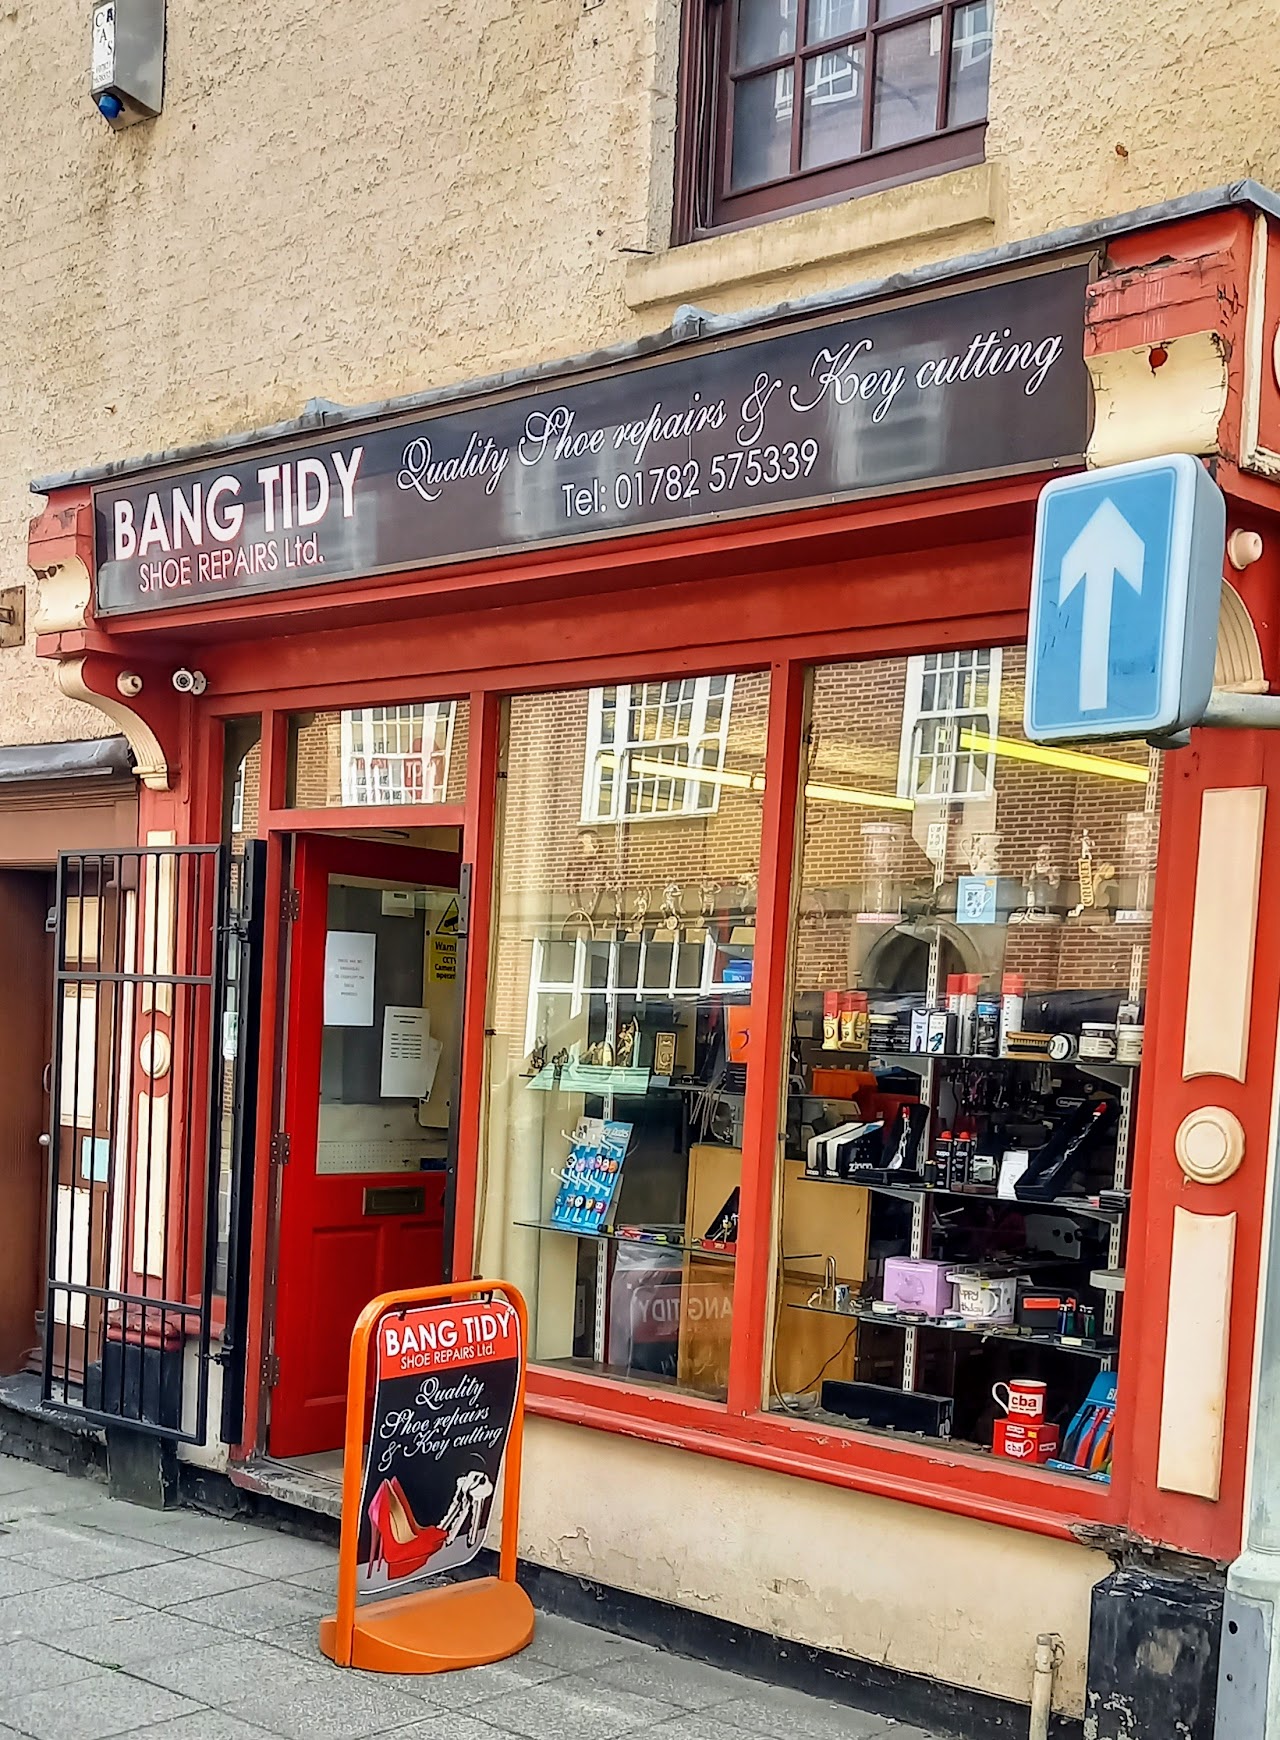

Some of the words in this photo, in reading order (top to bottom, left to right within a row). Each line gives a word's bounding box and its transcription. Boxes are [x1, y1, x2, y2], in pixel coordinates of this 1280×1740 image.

[397, 432, 509, 502] Quality
[518, 406, 605, 466] Shoe
[613, 393, 728, 465] repairs
[736, 372, 782, 446] &
[789, 338, 907, 423] Key
[915, 328, 1064, 396] cutting
[562, 480, 607, 517] Tel:
[614, 460, 701, 510] 01782
[708, 438, 818, 493] 575339
[113, 475, 245, 561] BANG
[256, 446, 364, 533] TIDY
[139, 555, 192, 592] SHOE
[198, 539, 279, 583] REPAIRS
[285, 532, 326, 568] Ltd.
[385, 1320, 458, 1357] BANG
[462, 1309, 515, 1344] TIDY
[400, 1353, 430, 1370] SHOE
[433, 1346, 475, 1364] REPAIRS
[476, 1343, 496, 1357] Ltd.
[415, 1374, 485, 1410] Quality
[1012, 1395, 1037, 1407] cba
[380, 1409, 430, 1439] Shoe
[433, 1404, 490, 1436] repairs
[378, 1441, 402, 1472] &
[403, 1428, 450, 1460] Key
[453, 1424, 504, 1449] cutting
